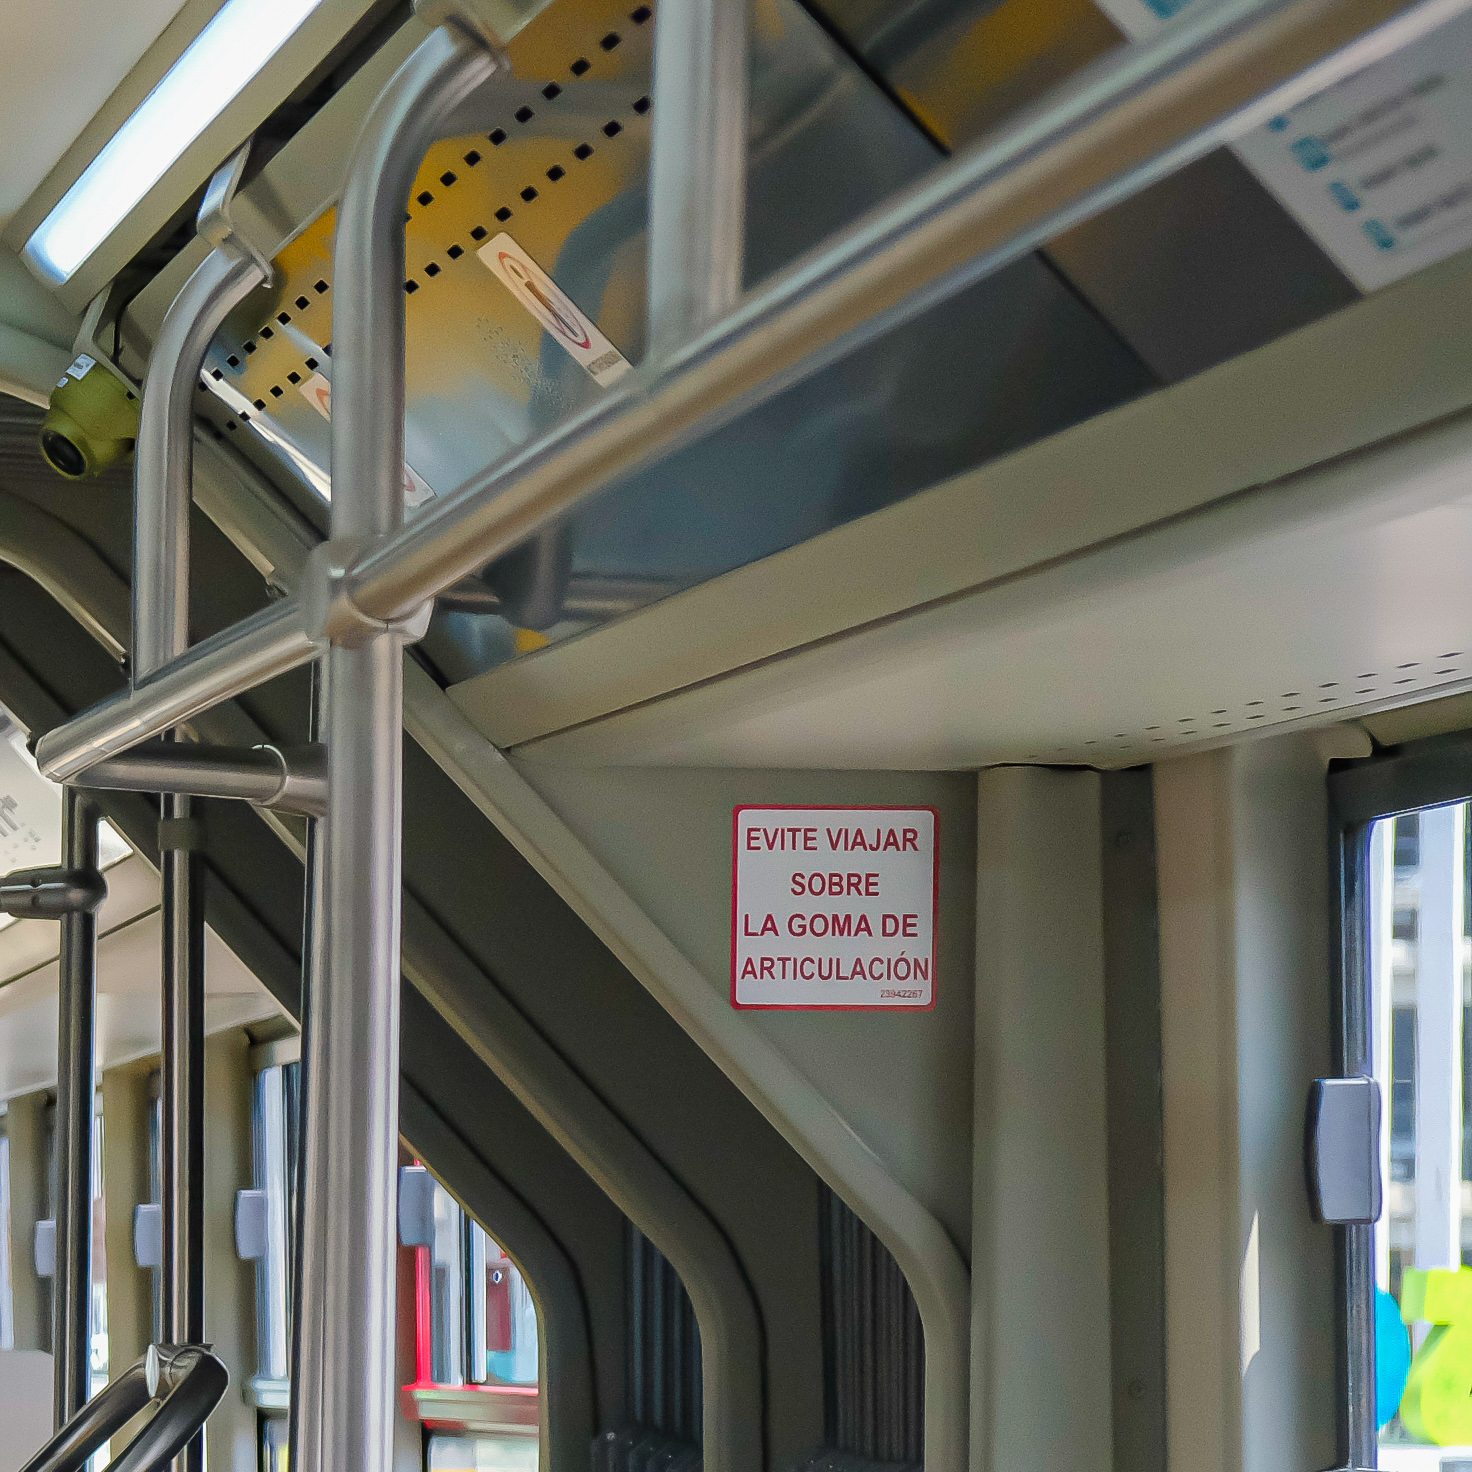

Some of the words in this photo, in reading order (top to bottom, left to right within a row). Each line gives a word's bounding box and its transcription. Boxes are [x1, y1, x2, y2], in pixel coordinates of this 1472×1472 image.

[746, 827, 818, 851] EVITE
[826, 827, 919, 852] VIAJAR
[790, 872, 880, 897] SOBRE
[743, 913, 779, 937] LA
[787, 913, 873, 938] GOMA
[881, 913, 918, 938] DE
[741, 951, 929, 981] ARTICULACIÓN
